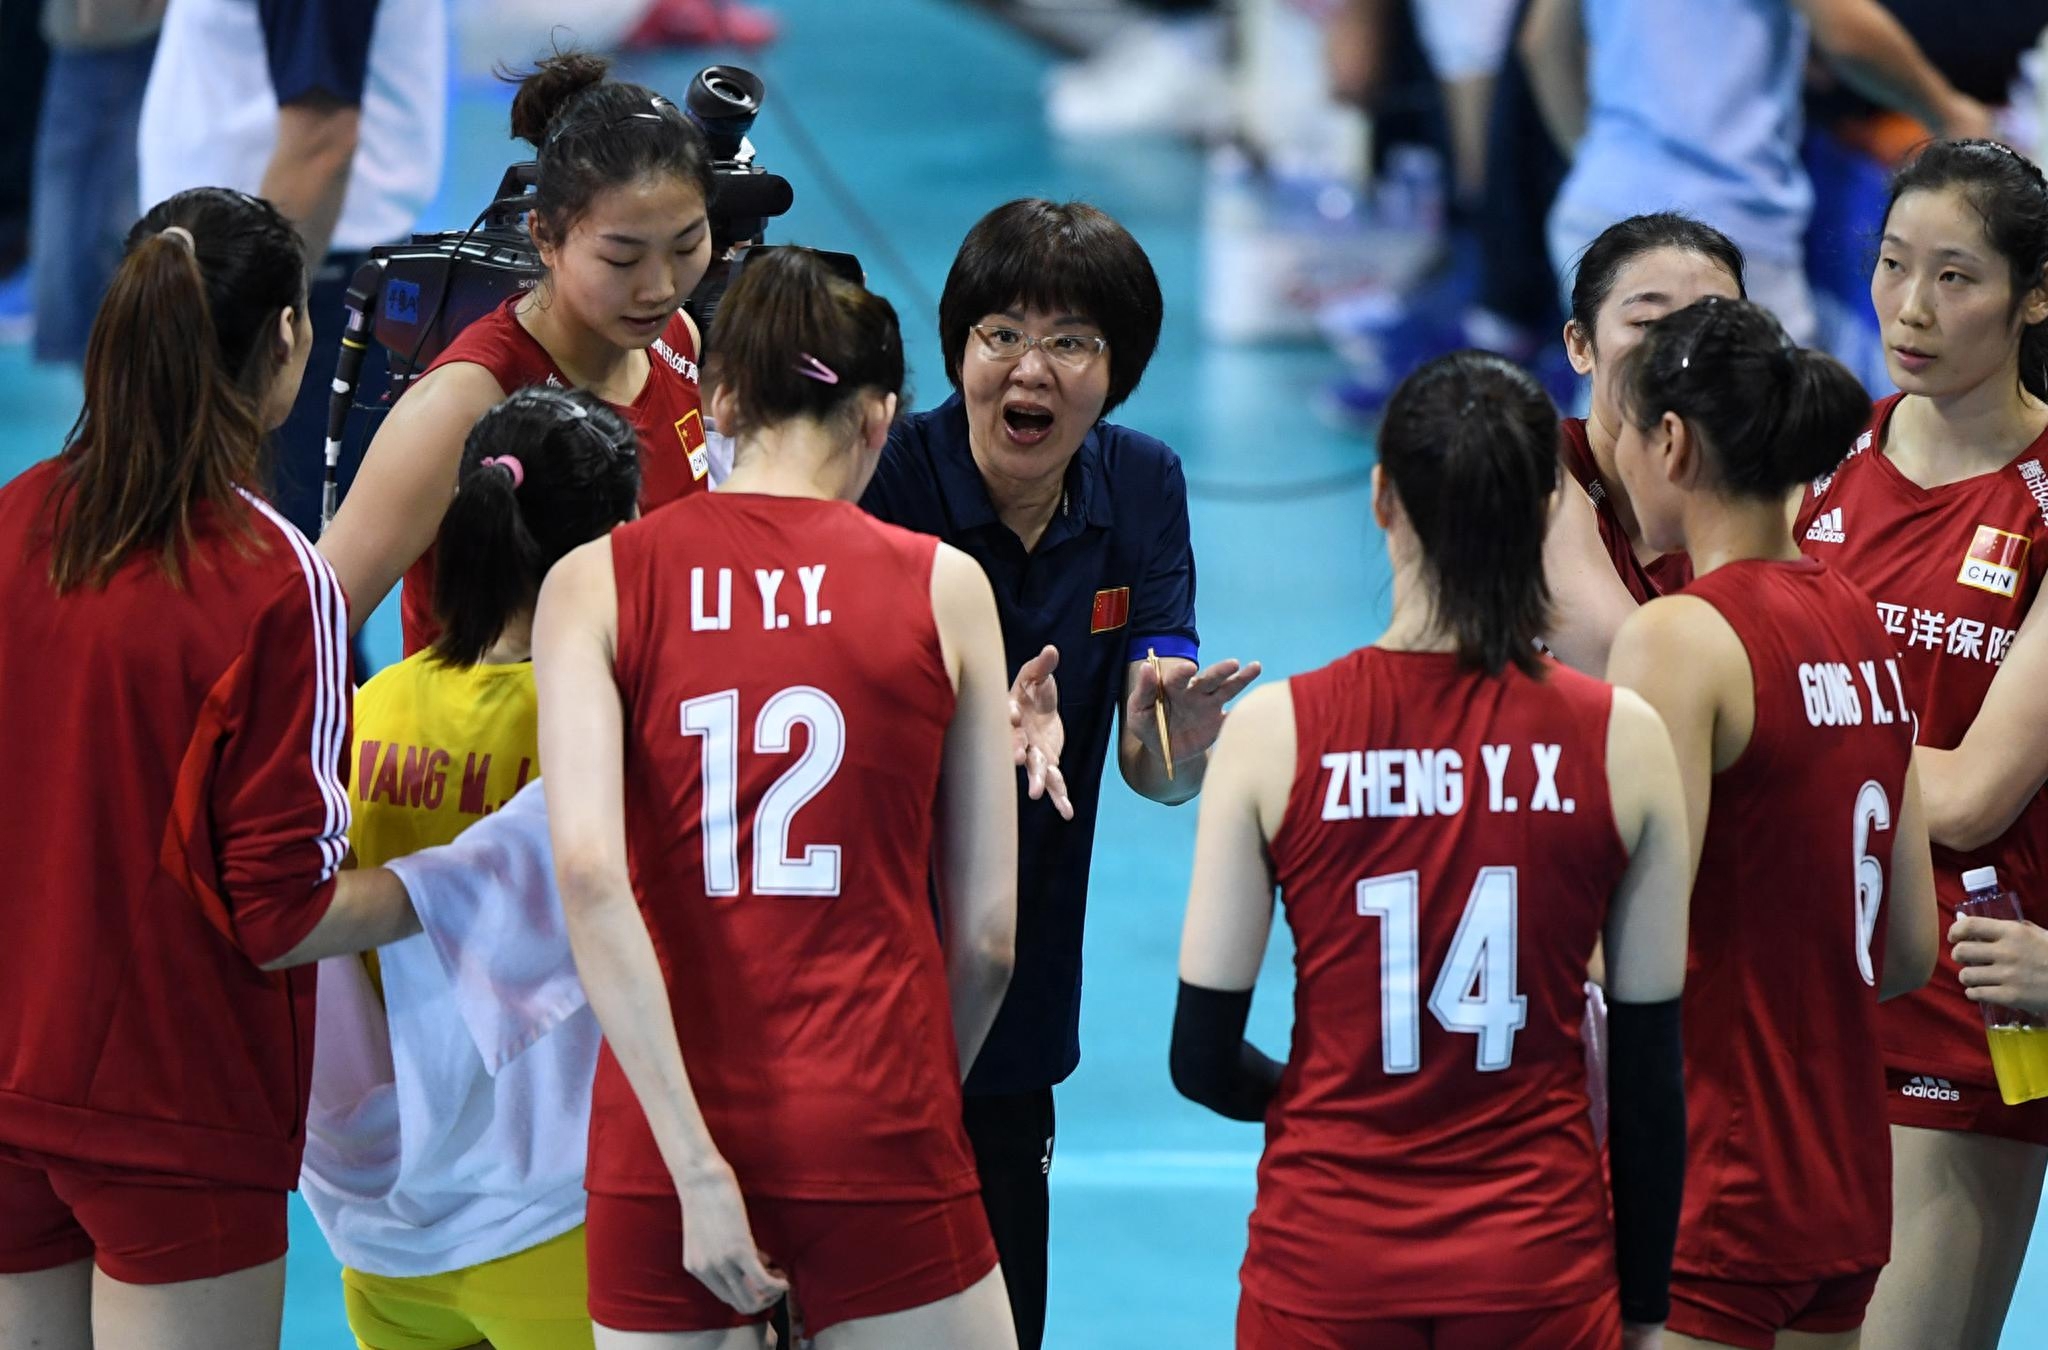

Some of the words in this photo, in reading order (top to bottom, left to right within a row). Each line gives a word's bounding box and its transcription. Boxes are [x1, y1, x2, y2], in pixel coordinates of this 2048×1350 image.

[1806, 527, 1845, 544] adidas
[690, 566, 732, 632] LI
[1967, 565, 2011, 590] CHN
[1798, 661, 1863, 727] GONG
[358, 740, 450, 811] WANG
[680, 684, 846, 897] 12
[1321, 747, 1464, 821] ZHENG
[1853, 779, 1890, 987] 6
[1356, 866, 1528, 1074] 14
[1902, 1084, 1960, 1101] adidas
